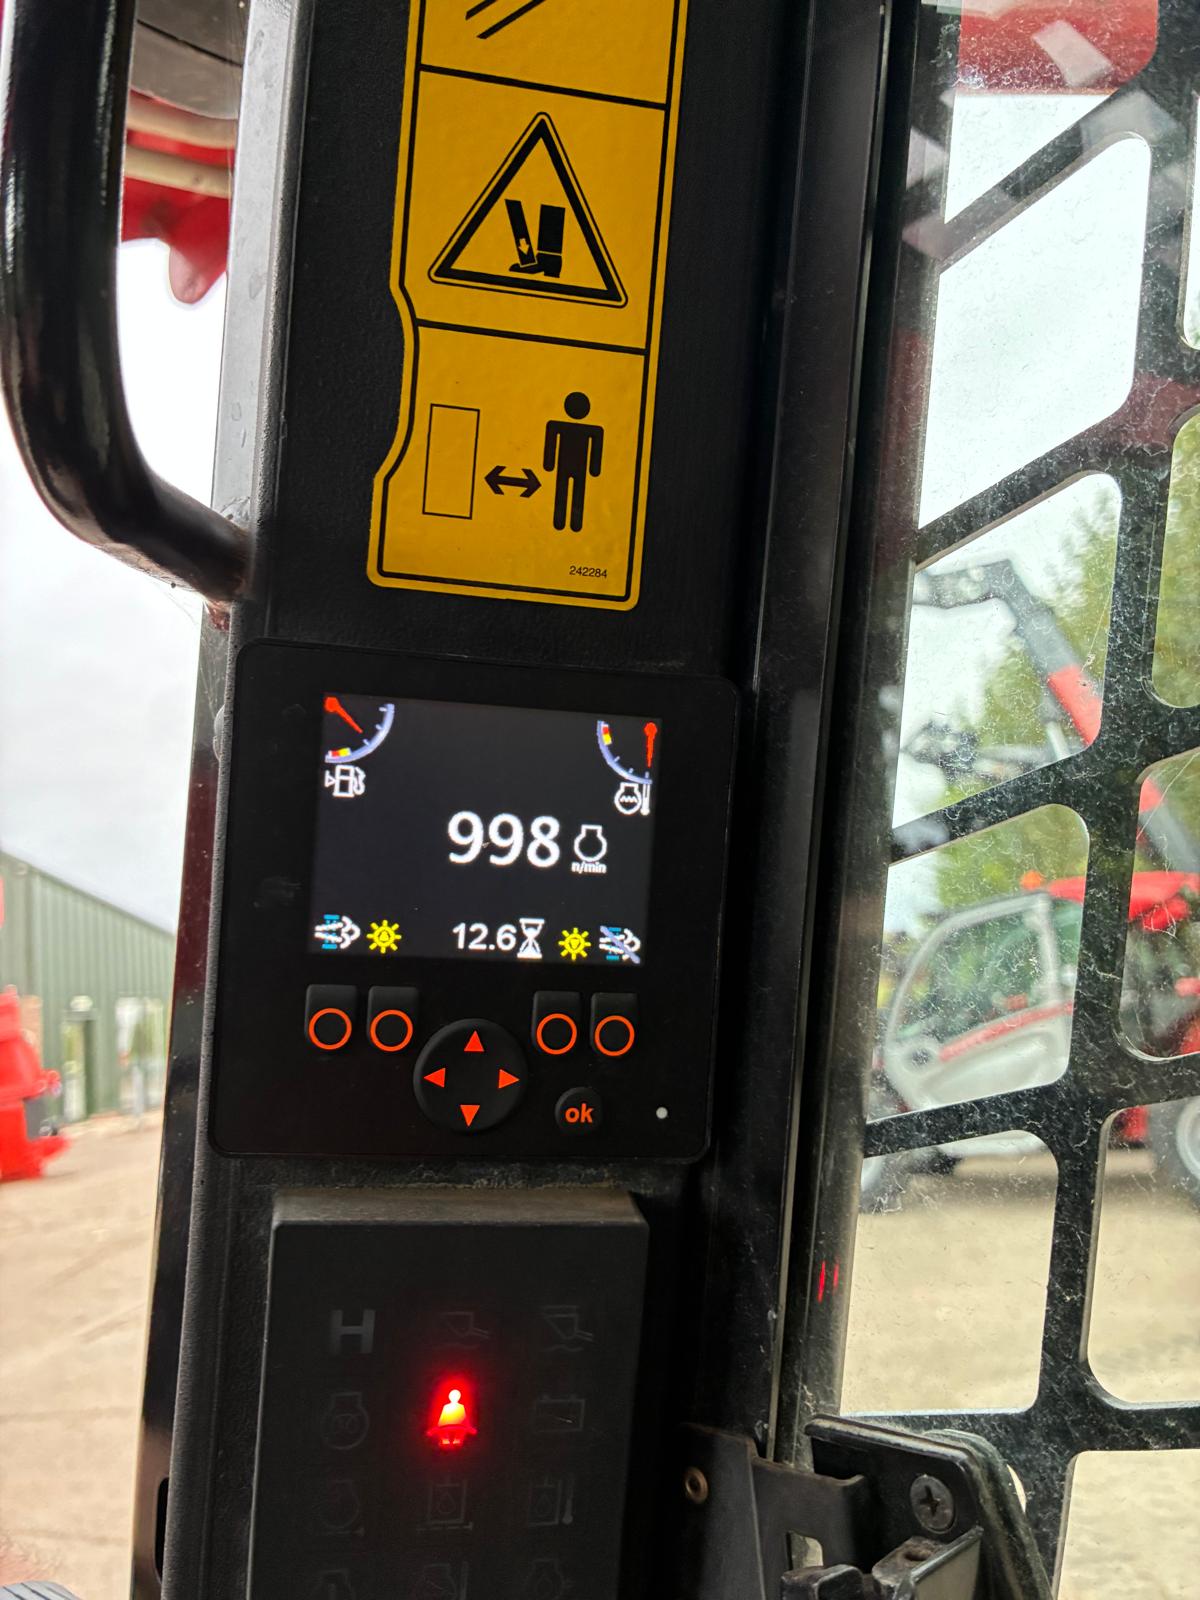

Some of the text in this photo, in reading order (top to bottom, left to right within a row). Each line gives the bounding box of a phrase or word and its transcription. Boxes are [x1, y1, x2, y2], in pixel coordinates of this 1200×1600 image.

[569, 565, 607, 579] 242284
[447, 811, 561, 868] 998
[571, 861, 607, 874] n/min
[452, 922, 516, 952] 12.6
[565, 1102, 594, 1123] ok
